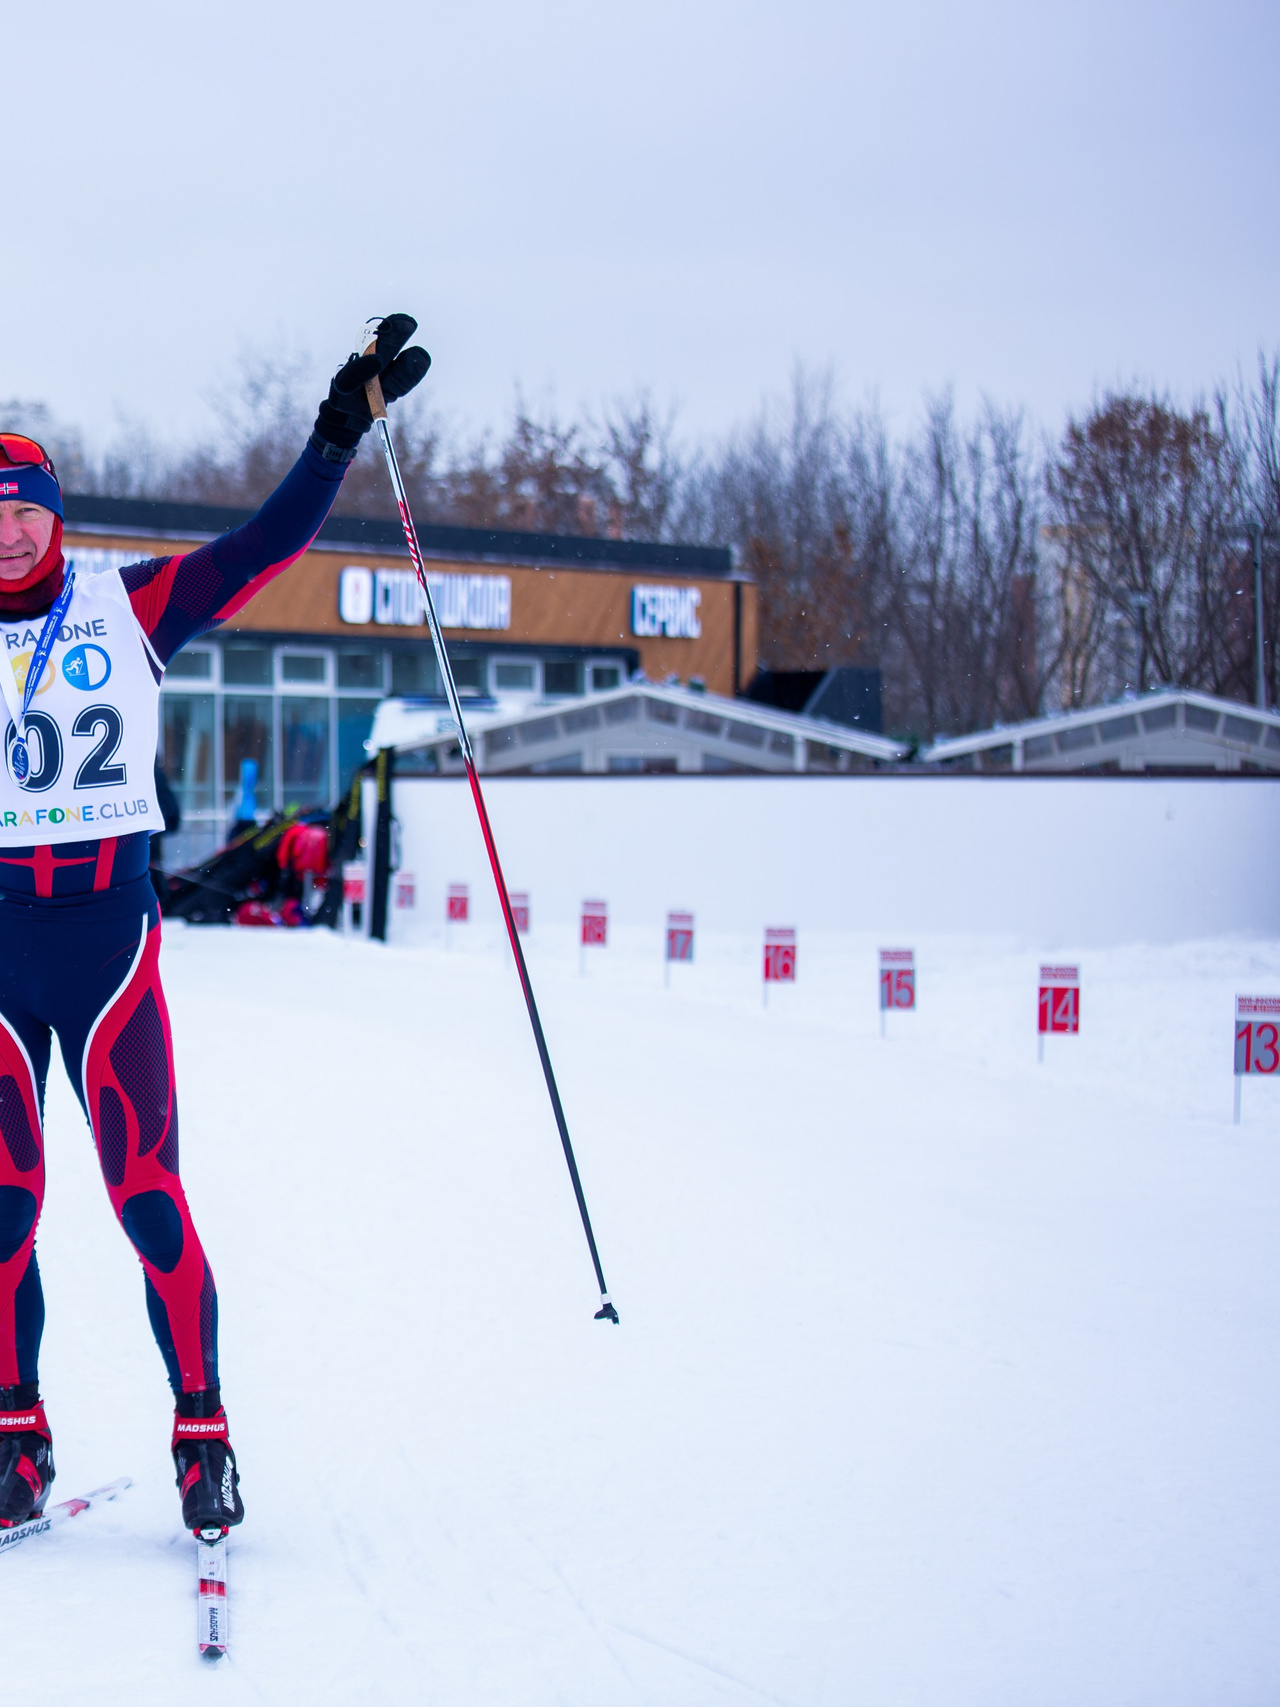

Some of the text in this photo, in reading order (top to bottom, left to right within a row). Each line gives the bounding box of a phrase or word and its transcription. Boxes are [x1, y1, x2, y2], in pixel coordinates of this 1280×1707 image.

[669, 929, 693, 960] 17
[765, 946, 795, 981] 16
[881, 970, 914, 1009] 15
[1040, 988, 1078, 1033] 14
[1237, 1021, 1280, 1074] 13
[177, 1423, 225, 1432] MADSHUS
[208, 1607, 218, 1642] MADSHUS
